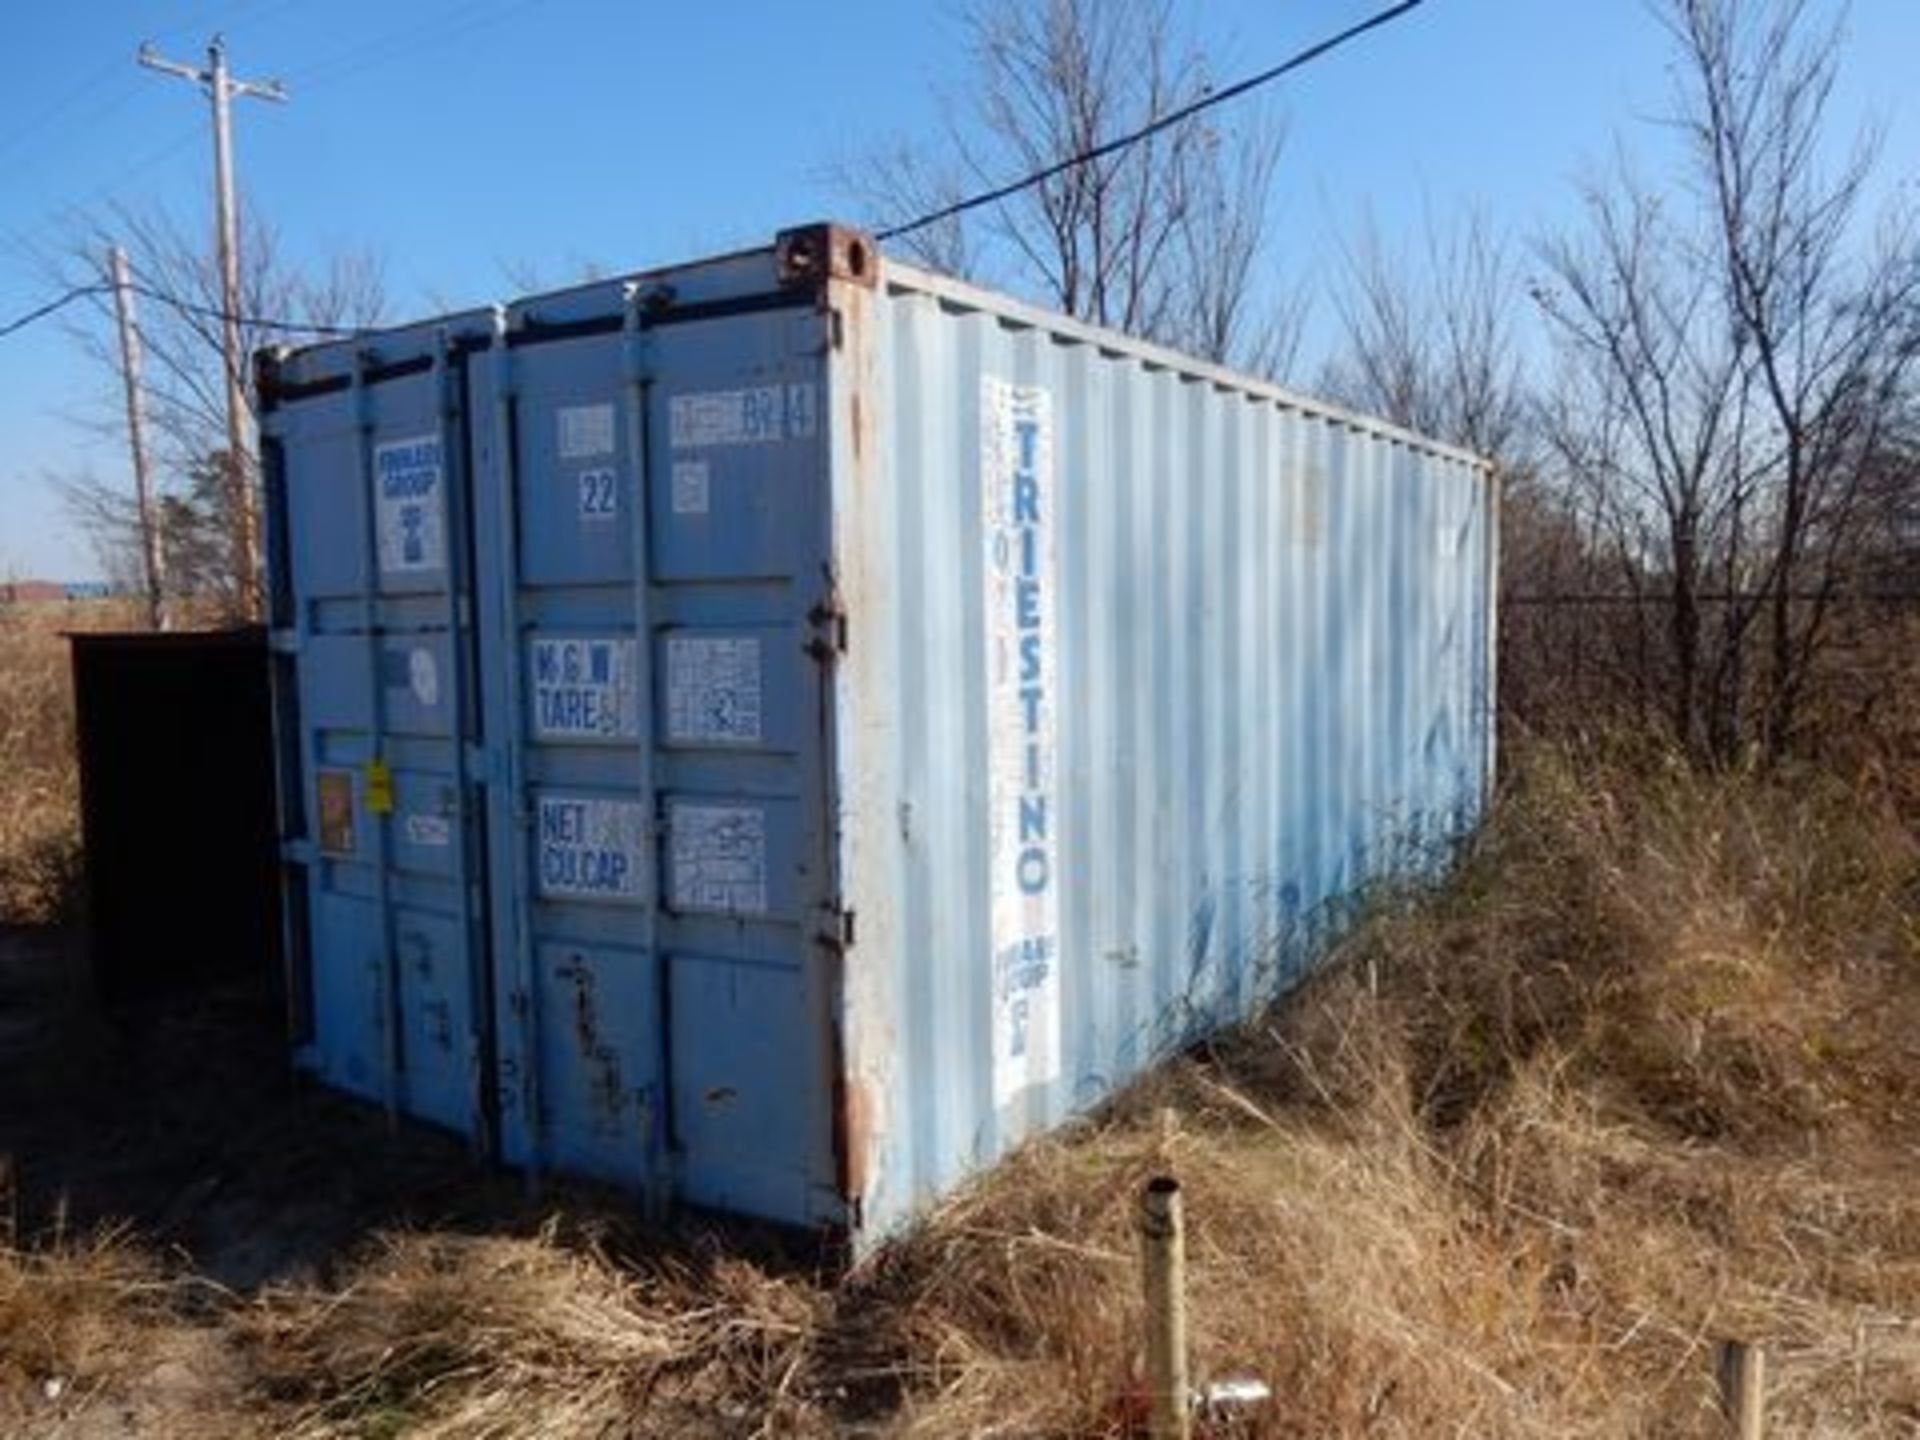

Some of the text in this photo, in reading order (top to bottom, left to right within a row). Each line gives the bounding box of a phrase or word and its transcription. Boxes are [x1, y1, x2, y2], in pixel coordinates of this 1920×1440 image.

[583, 473, 614, 513] 22
[1014, 420, 1049, 895] TRIESTINO
[538, 687, 597, 729] TARE
[542, 803, 586, 844] NET
